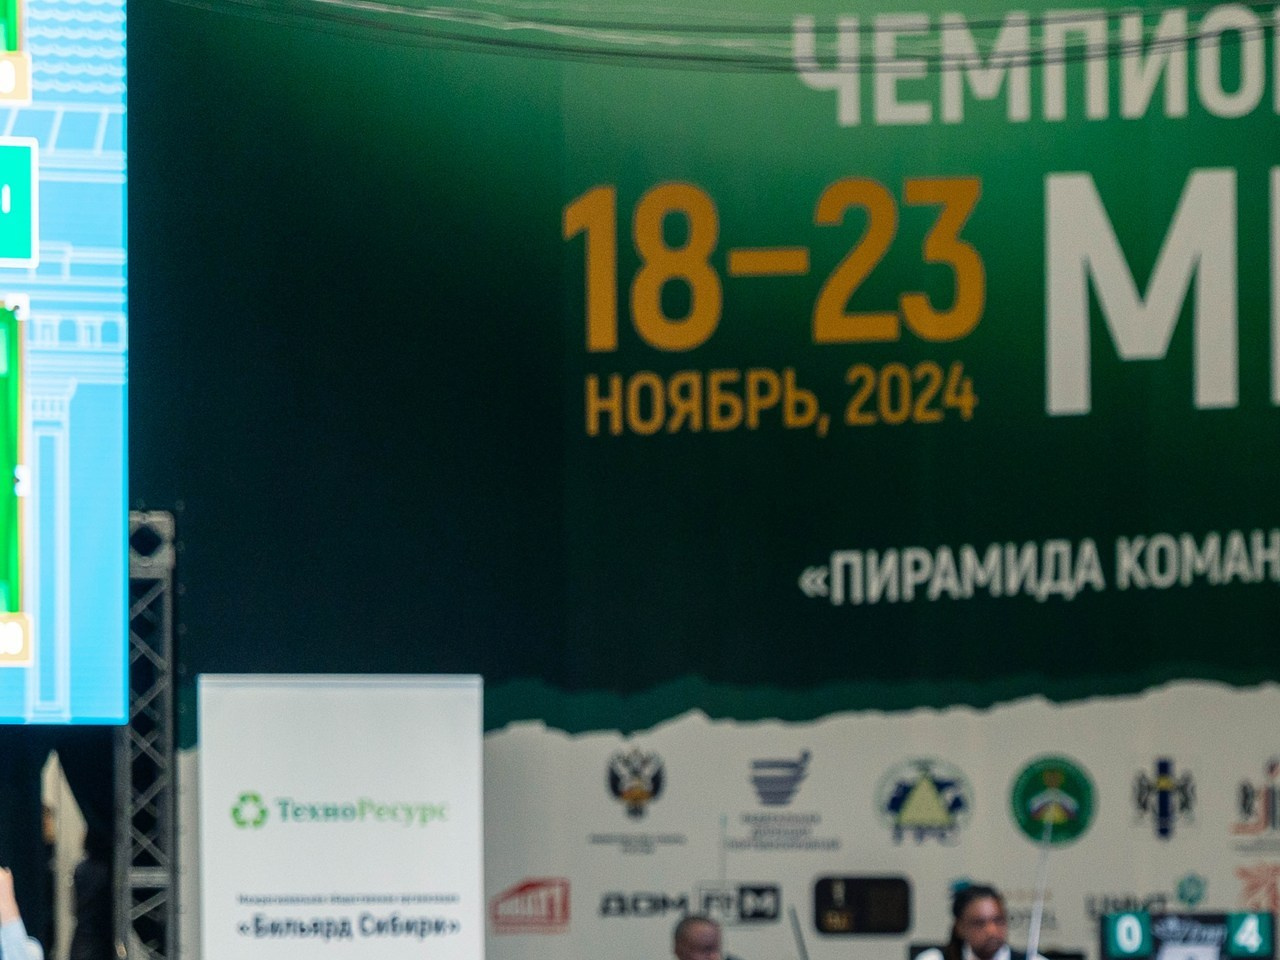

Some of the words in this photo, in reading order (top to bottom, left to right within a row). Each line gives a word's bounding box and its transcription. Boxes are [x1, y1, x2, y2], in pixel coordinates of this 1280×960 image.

[584, 368, 830, 437] НОЯБРЬ,
[844, 362, 978, 427] 2024
[799, 540, 1106, 605] «ПИРАМИДА
[275, 797, 448, 826] ТехноРесурс
[1116, 914, 1143, 953] 0
[1235, 914, 1262, 953] 4
